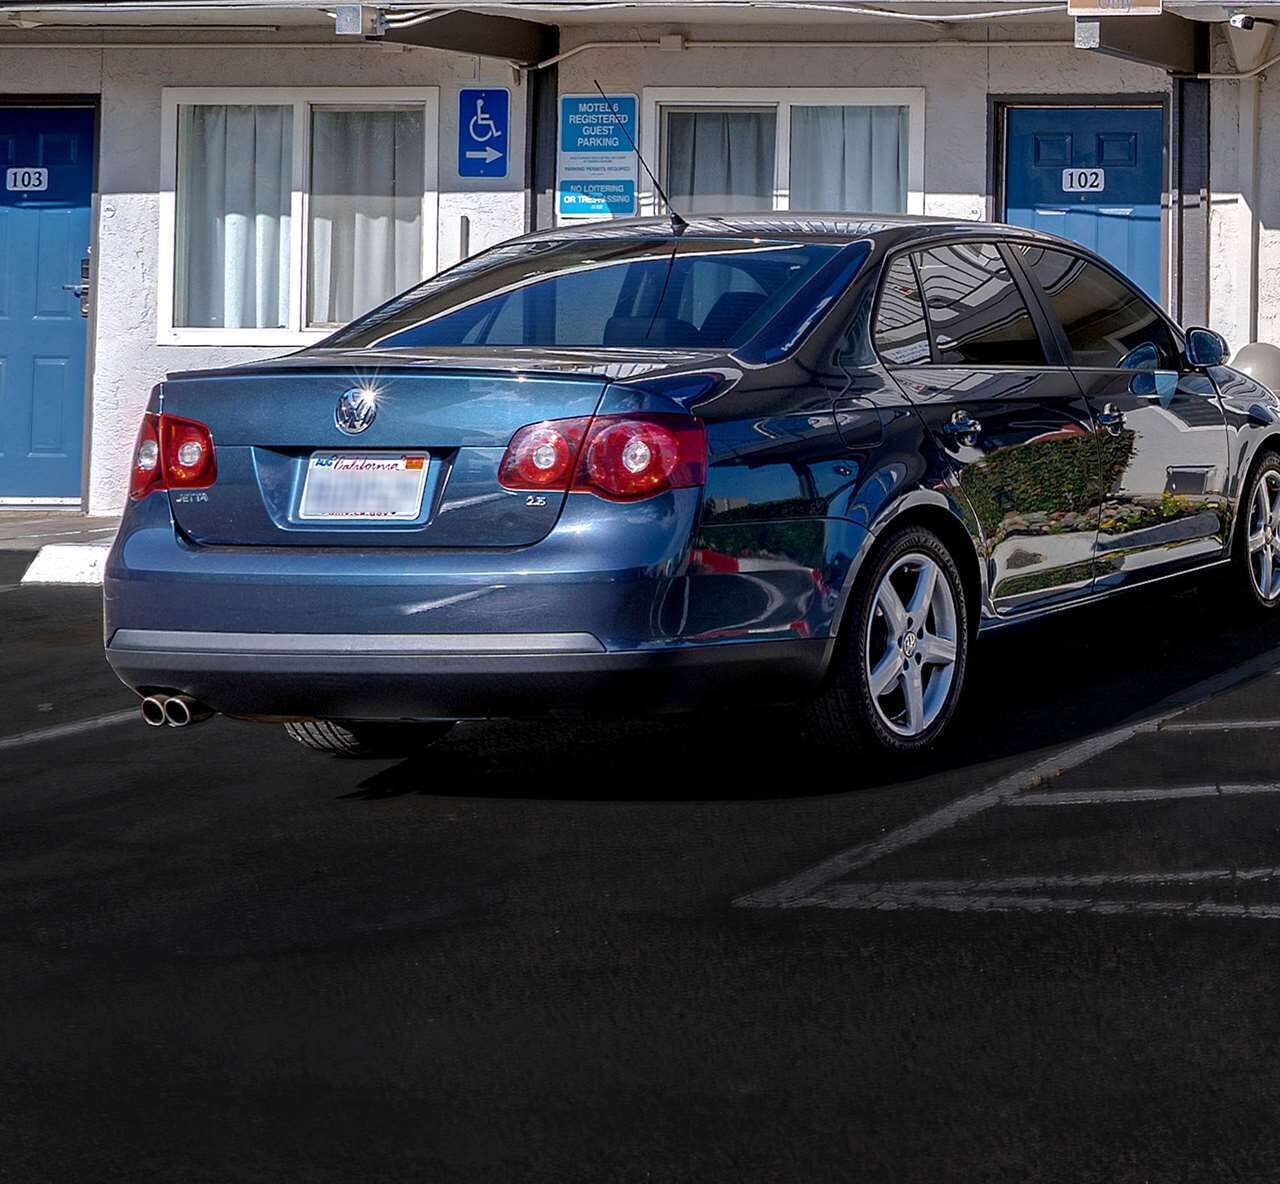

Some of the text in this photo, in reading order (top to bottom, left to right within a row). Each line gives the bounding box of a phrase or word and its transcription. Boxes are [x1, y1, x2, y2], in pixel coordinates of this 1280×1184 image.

[578, 103, 620, 112] MOTEL 6
[569, 114, 629, 124] REGISTERED
[582, 126, 614, 135] GUEST
[577, 137, 619, 147] PARKING
[12, 171, 42, 187] 103
[1068, 171, 1100, 188] 102
[570, 184, 625, 193] NO LOITERING
[563, 195, 576, 204] OR
[333, 456, 400, 472] California
